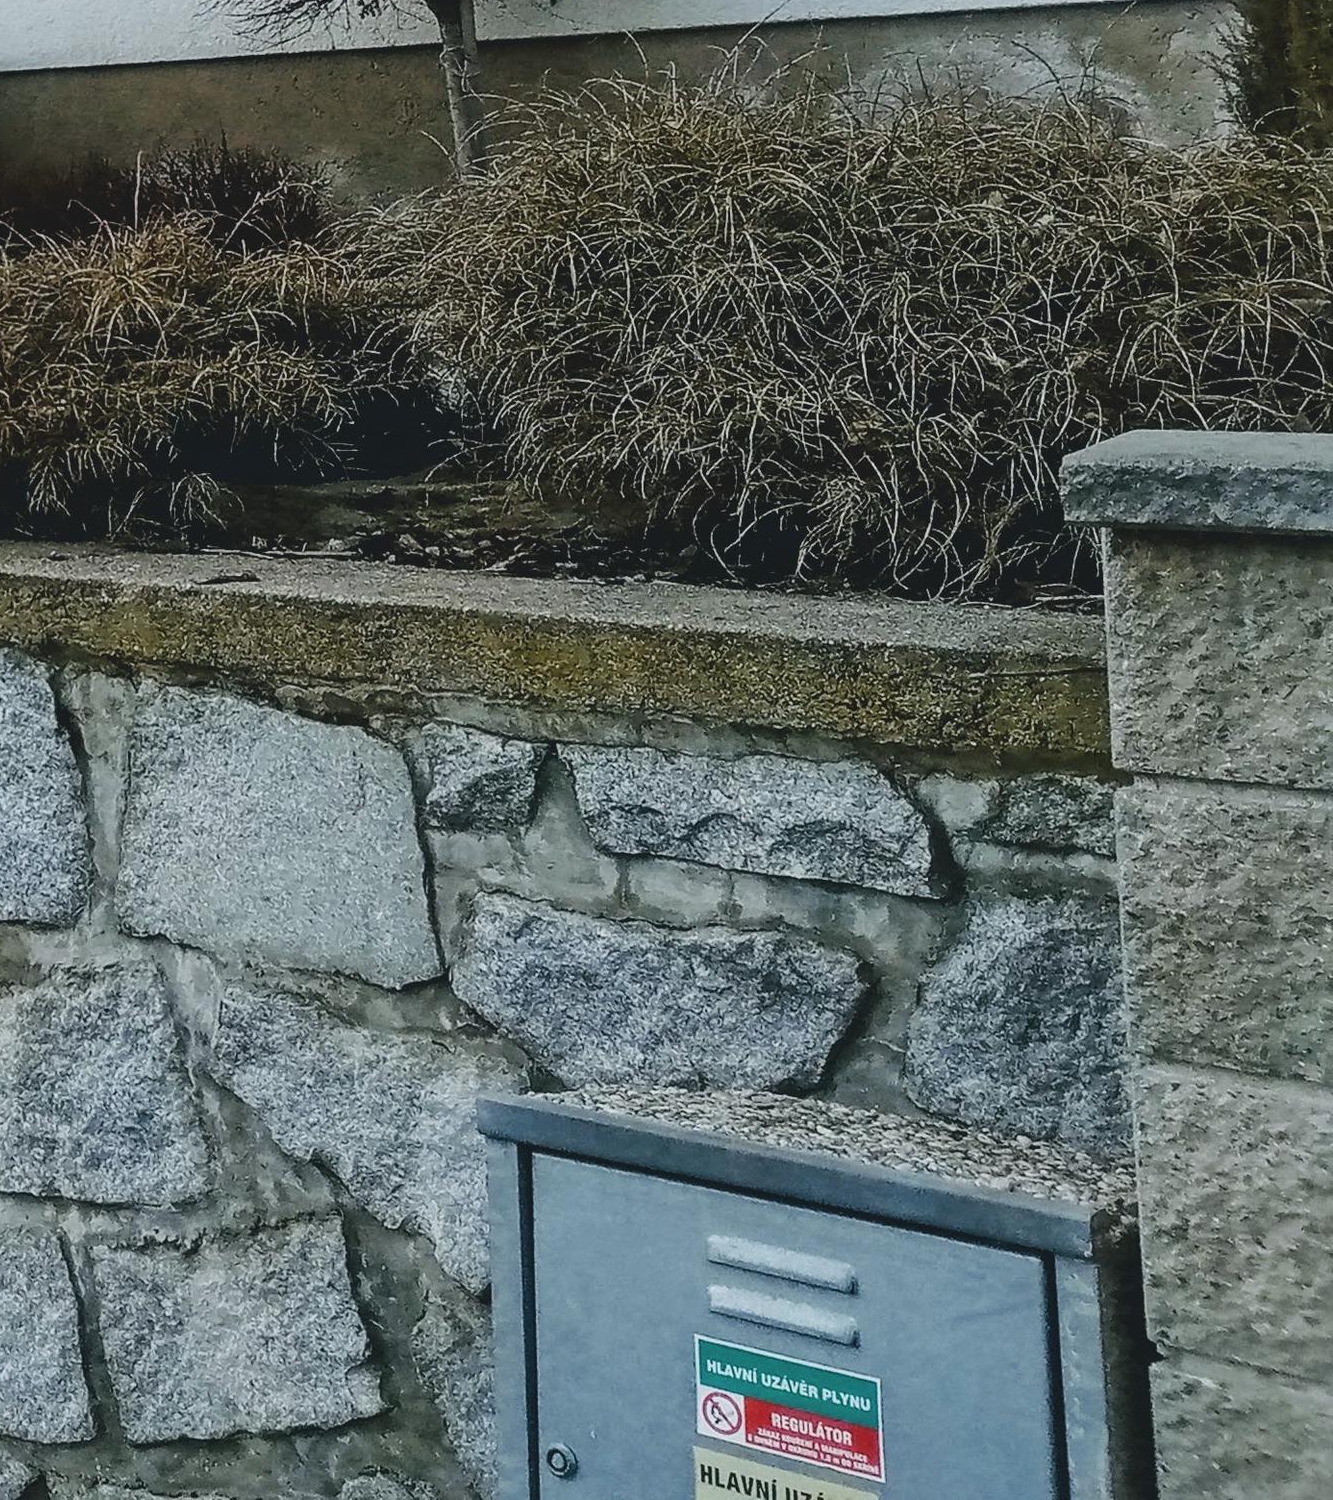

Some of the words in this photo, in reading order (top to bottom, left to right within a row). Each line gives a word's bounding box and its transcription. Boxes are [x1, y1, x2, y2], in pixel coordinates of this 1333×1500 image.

[706, 1359, 757, 1384] HLAVNÍ
[761, 1372, 819, 1398] UZÁVĚR
[822, 1388, 871, 1411] PLYNU
[771, 1412, 853, 1446] REGULÁTOR
[700, 1464, 777, 1500] HLAVNÍ
